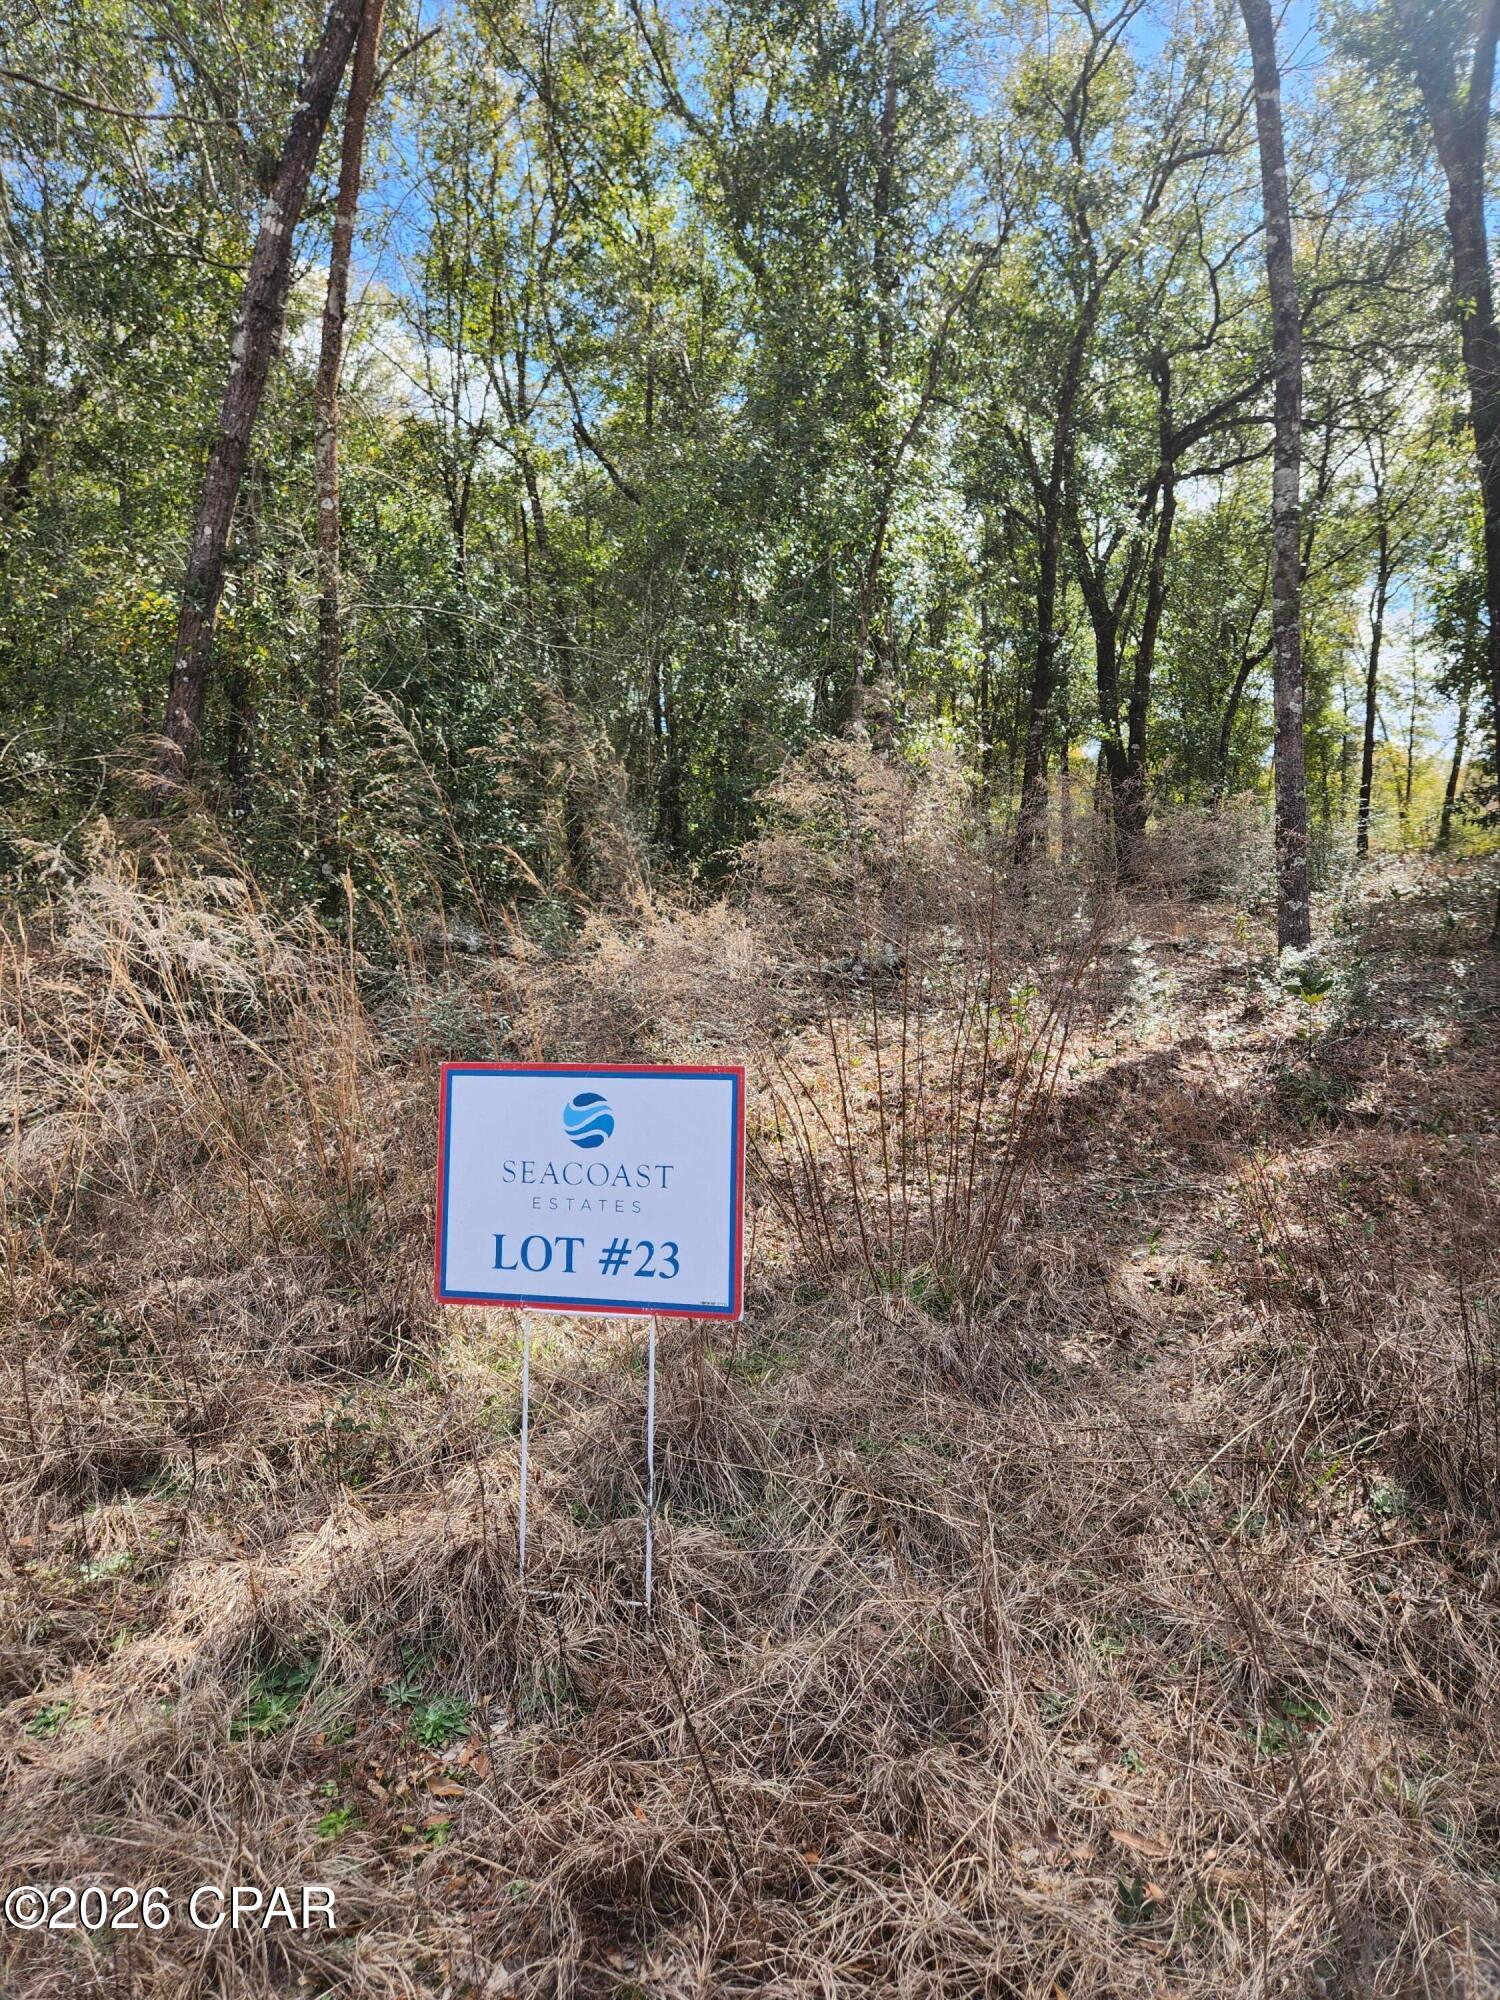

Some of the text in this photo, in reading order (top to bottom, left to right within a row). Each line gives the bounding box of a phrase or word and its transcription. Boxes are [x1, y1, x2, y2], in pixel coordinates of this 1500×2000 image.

[502, 1160, 674, 1189] SEACOAST
[532, 1196, 642, 1214] ESTATES
[492, 1234, 680, 1279] LOT #23
